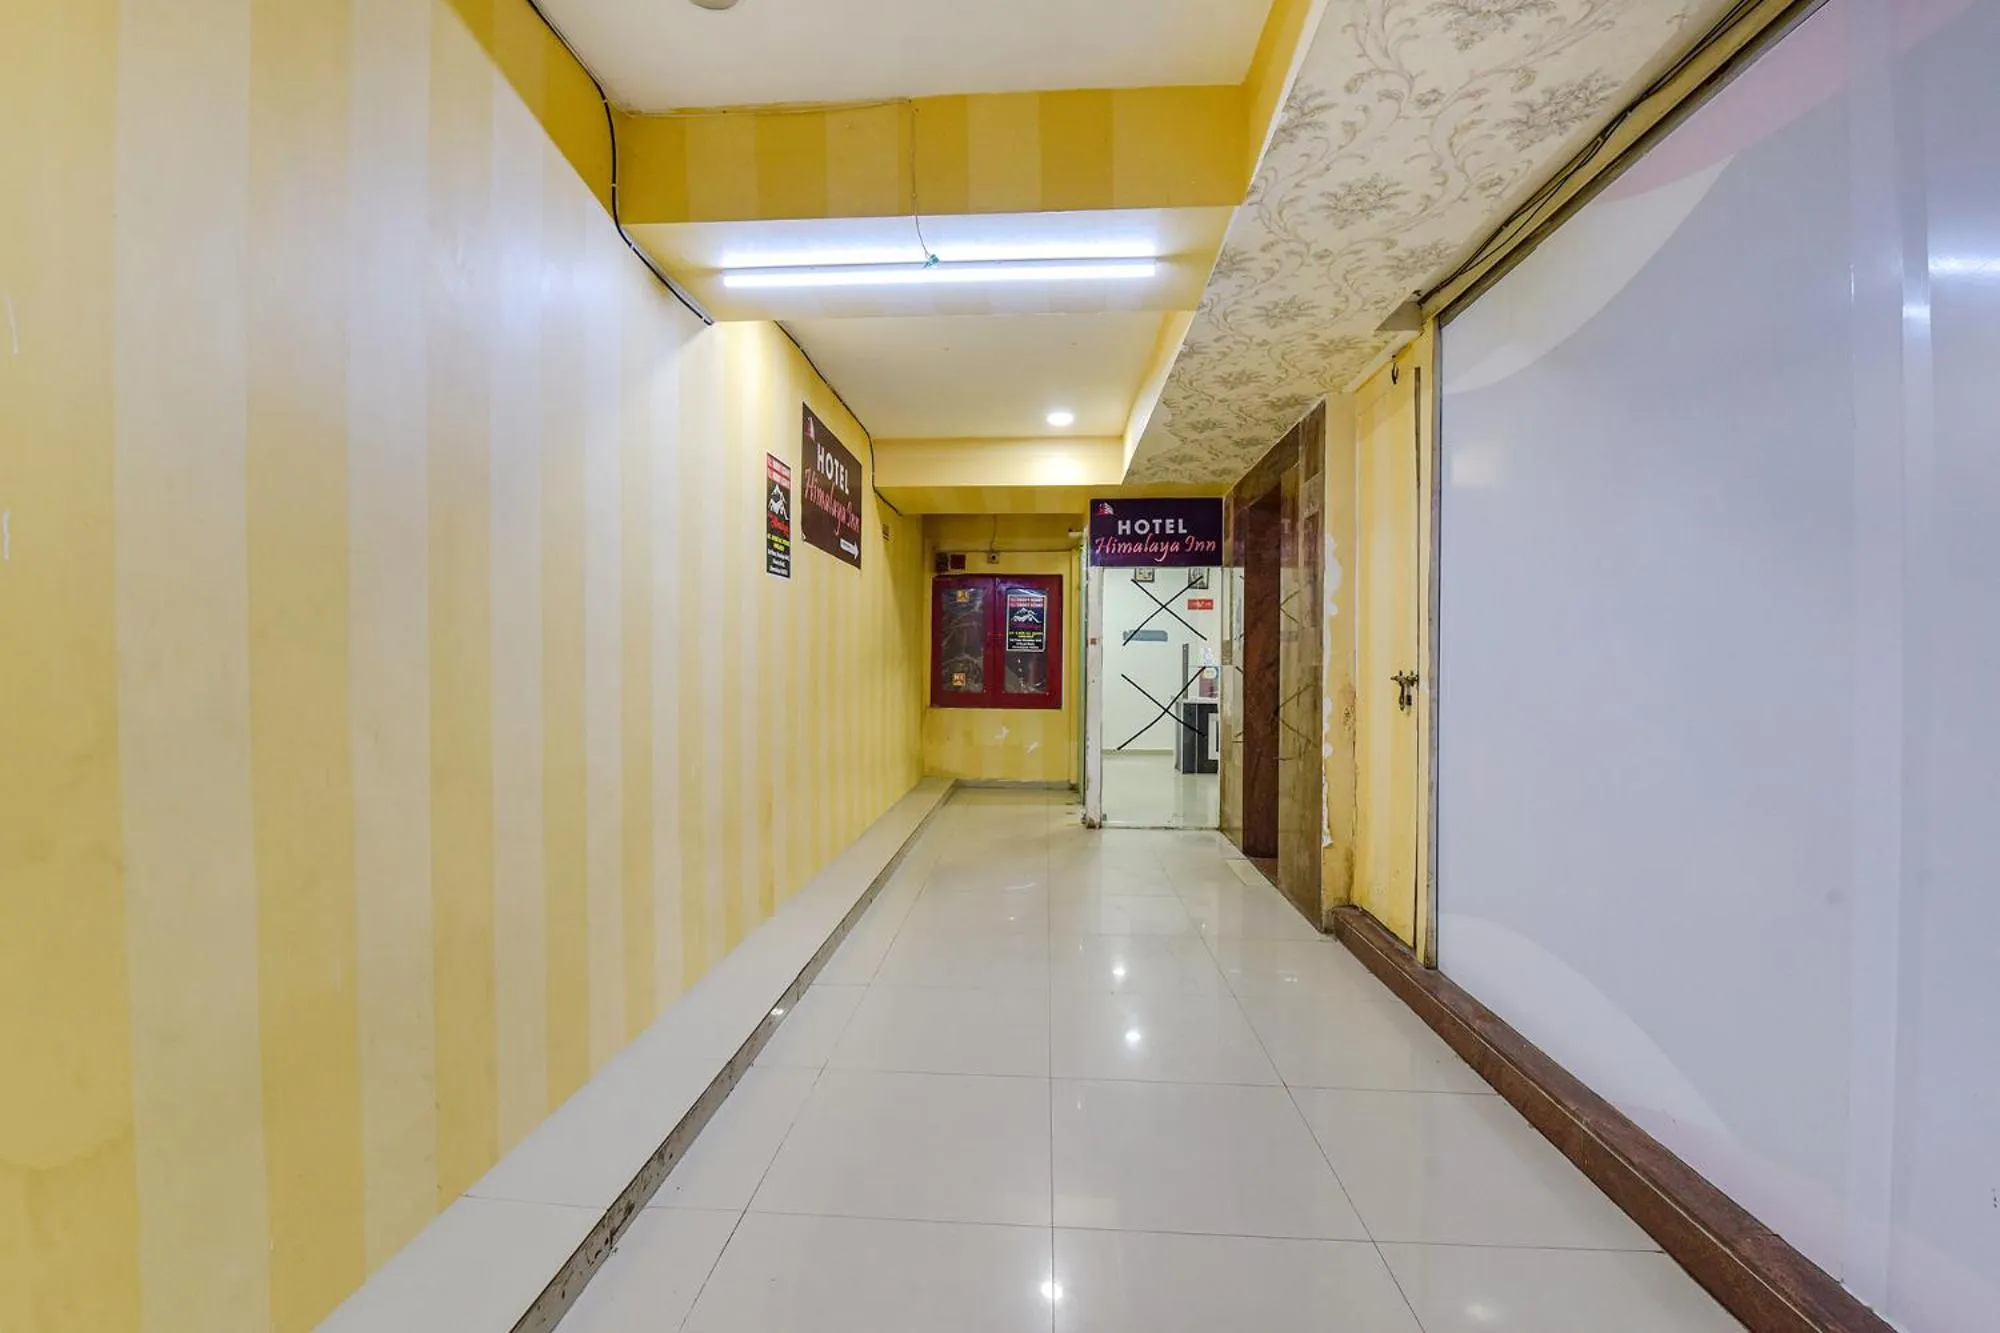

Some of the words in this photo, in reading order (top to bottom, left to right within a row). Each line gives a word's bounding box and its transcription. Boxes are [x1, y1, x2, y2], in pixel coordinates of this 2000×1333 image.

[816, 444, 849, 495] HOTEL
[805, 469, 846, 536] Himalaya
[847, 501, 860, 534] Inn
[1117, 518, 1188, 536] HOTEL
[1095, 533, 1181, 562] Himalaya
[1184, 535, 1217, 553] Inn
